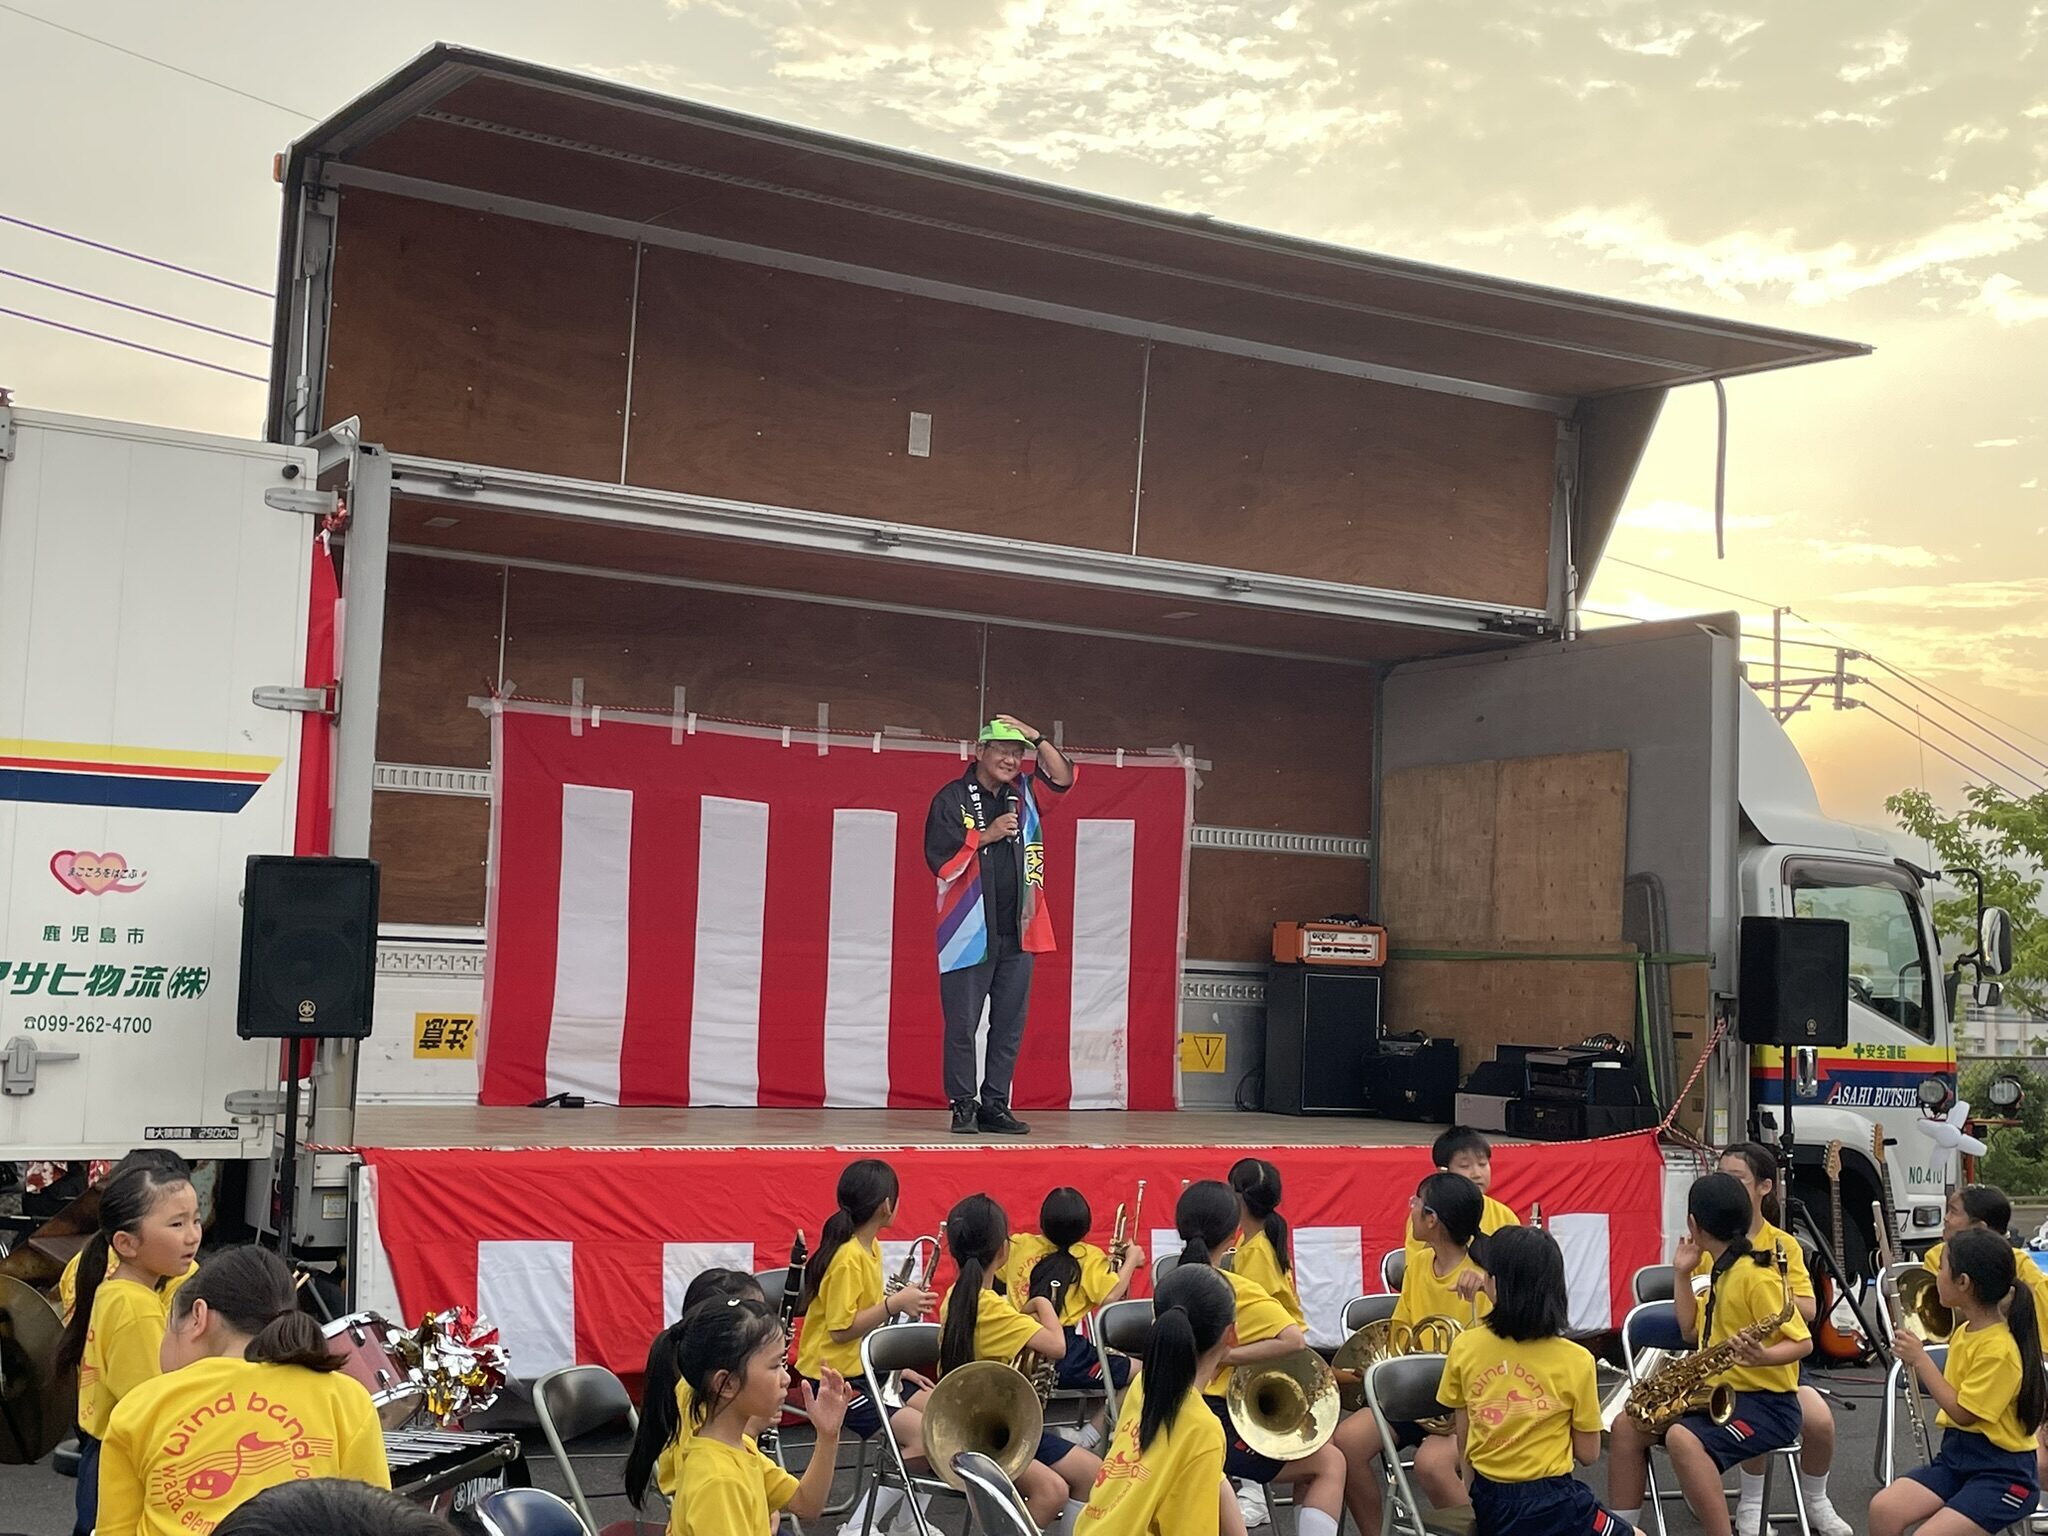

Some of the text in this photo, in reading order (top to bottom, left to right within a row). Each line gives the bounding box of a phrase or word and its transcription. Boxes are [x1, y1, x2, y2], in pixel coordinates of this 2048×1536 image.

[43, 925, 145, 944] 鹿児島市
[37, 1015, 152, 1033] 099-262-4700
[1826, 1081, 1874, 1106] ASAHI
[1471, 1360, 1549, 1411] wind band
[163, 1391, 315, 1460] wind band
[162, 1464, 185, 1514] wada
